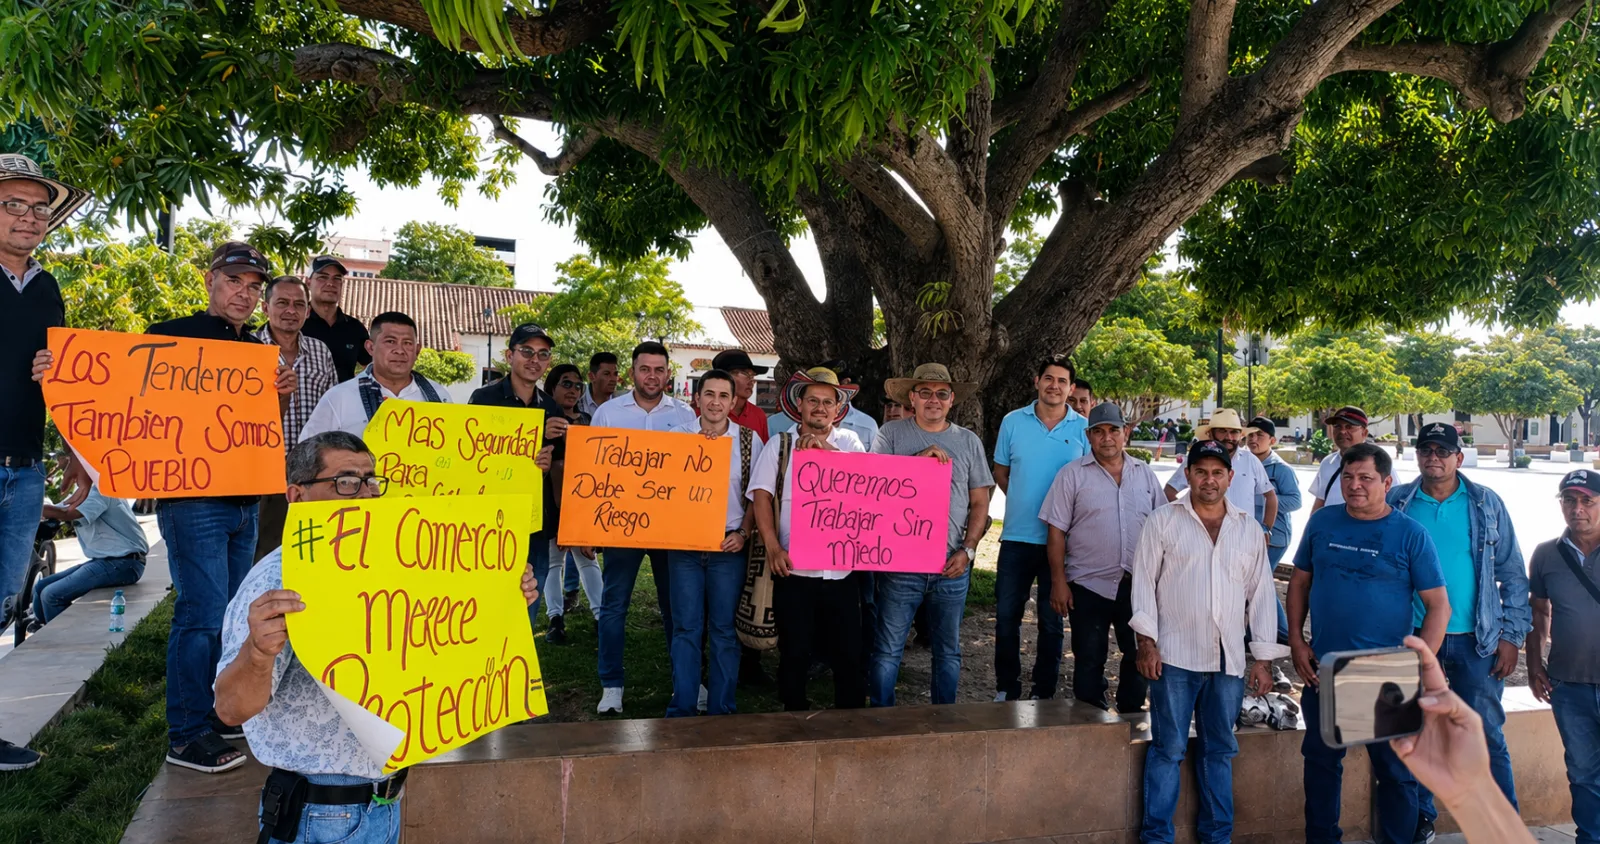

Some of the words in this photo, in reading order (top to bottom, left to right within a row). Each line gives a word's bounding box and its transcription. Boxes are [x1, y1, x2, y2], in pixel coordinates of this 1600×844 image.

[47, 333, 111, 385] Los
[128, 341, 264, 397] Tenderos
[51, 396, 183, 455] Tambien
[204, 404, 282, 453] Somos
[384, 407, 445, 450] Mas
[458, 417, 539, 473] Seguridad
[100, 448, 211, 492] PUEBLO
[378, 452, 428, 488] Para
[586, 435, 672, 476] Trabajar
[683, 444, 713, 473] No
[571, 472, 625, 499] Debe
[637, 480, 676, 500] Ser
[688, 484, 713, 503] un
[797, 461, 917, 501] Queremos
[593, 501, 650, 537] Riesgo
[801, 499, 883, 540] Trabajar
[893, 508, 933, 540] Sin
[395, 508, 517, 574] Comercio
